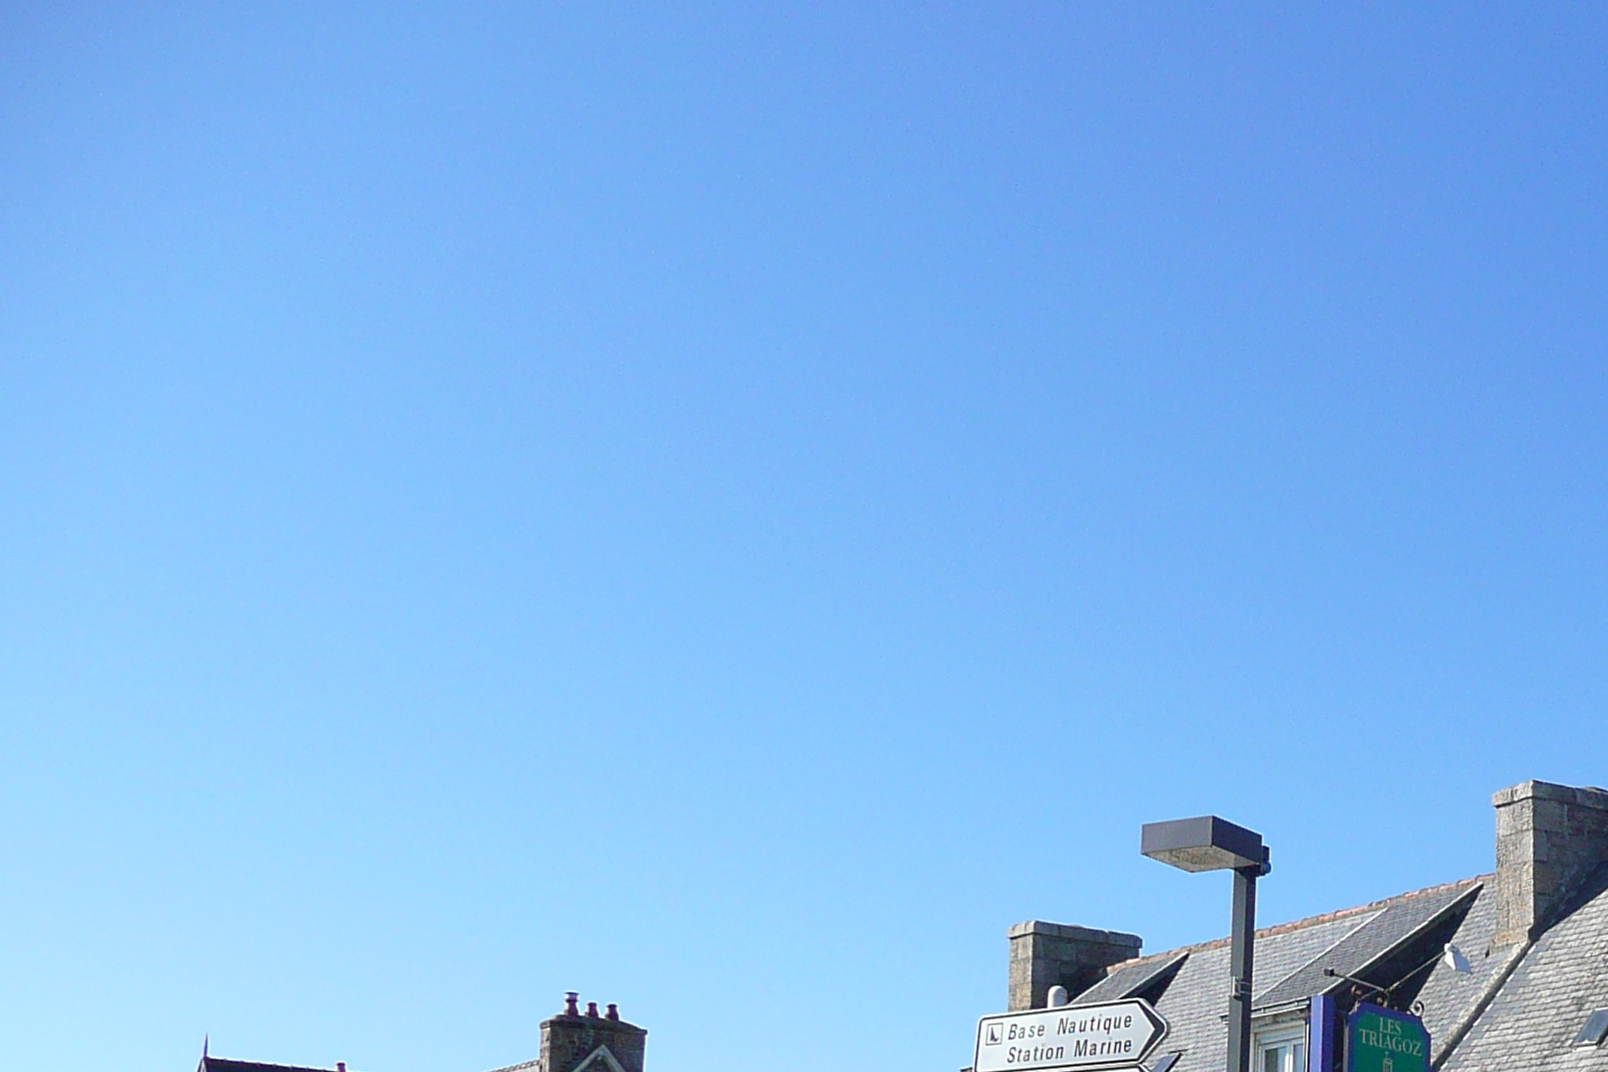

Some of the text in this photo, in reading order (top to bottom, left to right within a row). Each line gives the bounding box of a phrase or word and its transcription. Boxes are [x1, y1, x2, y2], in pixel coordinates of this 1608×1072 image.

[1008, 1013, 1132, 1040] Base Nautique
[1379, 1017, 1402, 1036] LES
[1007, 1038, 1132, 1063] Station Marine
[1360, 1029, 1422, 1056] TRIAGOZ
